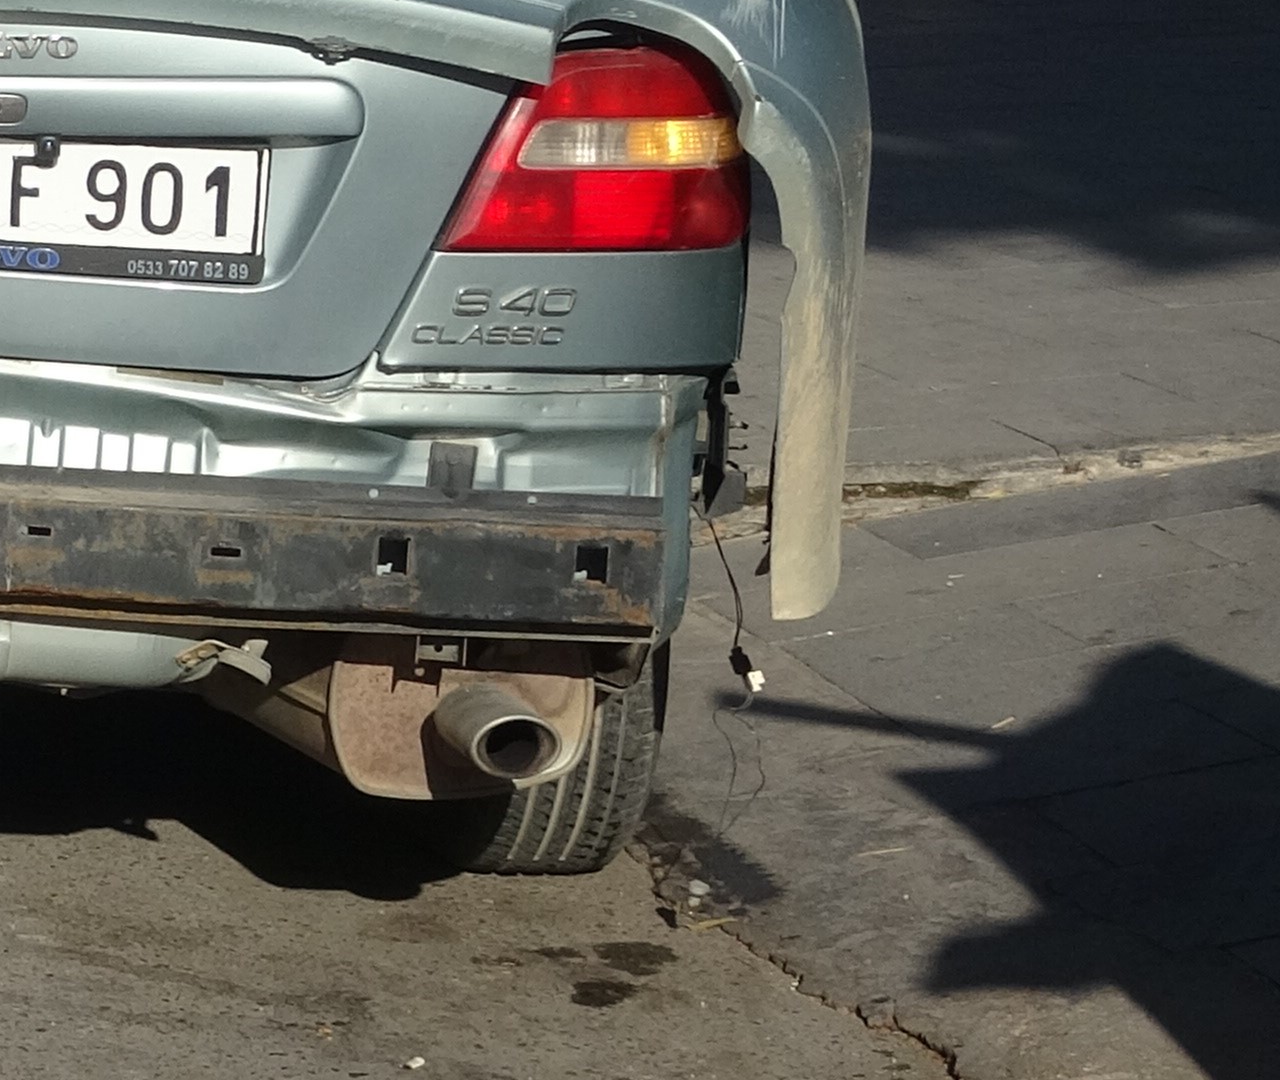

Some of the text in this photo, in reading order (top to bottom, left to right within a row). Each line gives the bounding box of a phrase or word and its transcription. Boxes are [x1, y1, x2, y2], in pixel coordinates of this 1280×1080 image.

[85, 159, 231, 238] 901
[127, 259, 249, 281] 0533 707 82 89
[411, 325, 566, 347] CLASSIC
